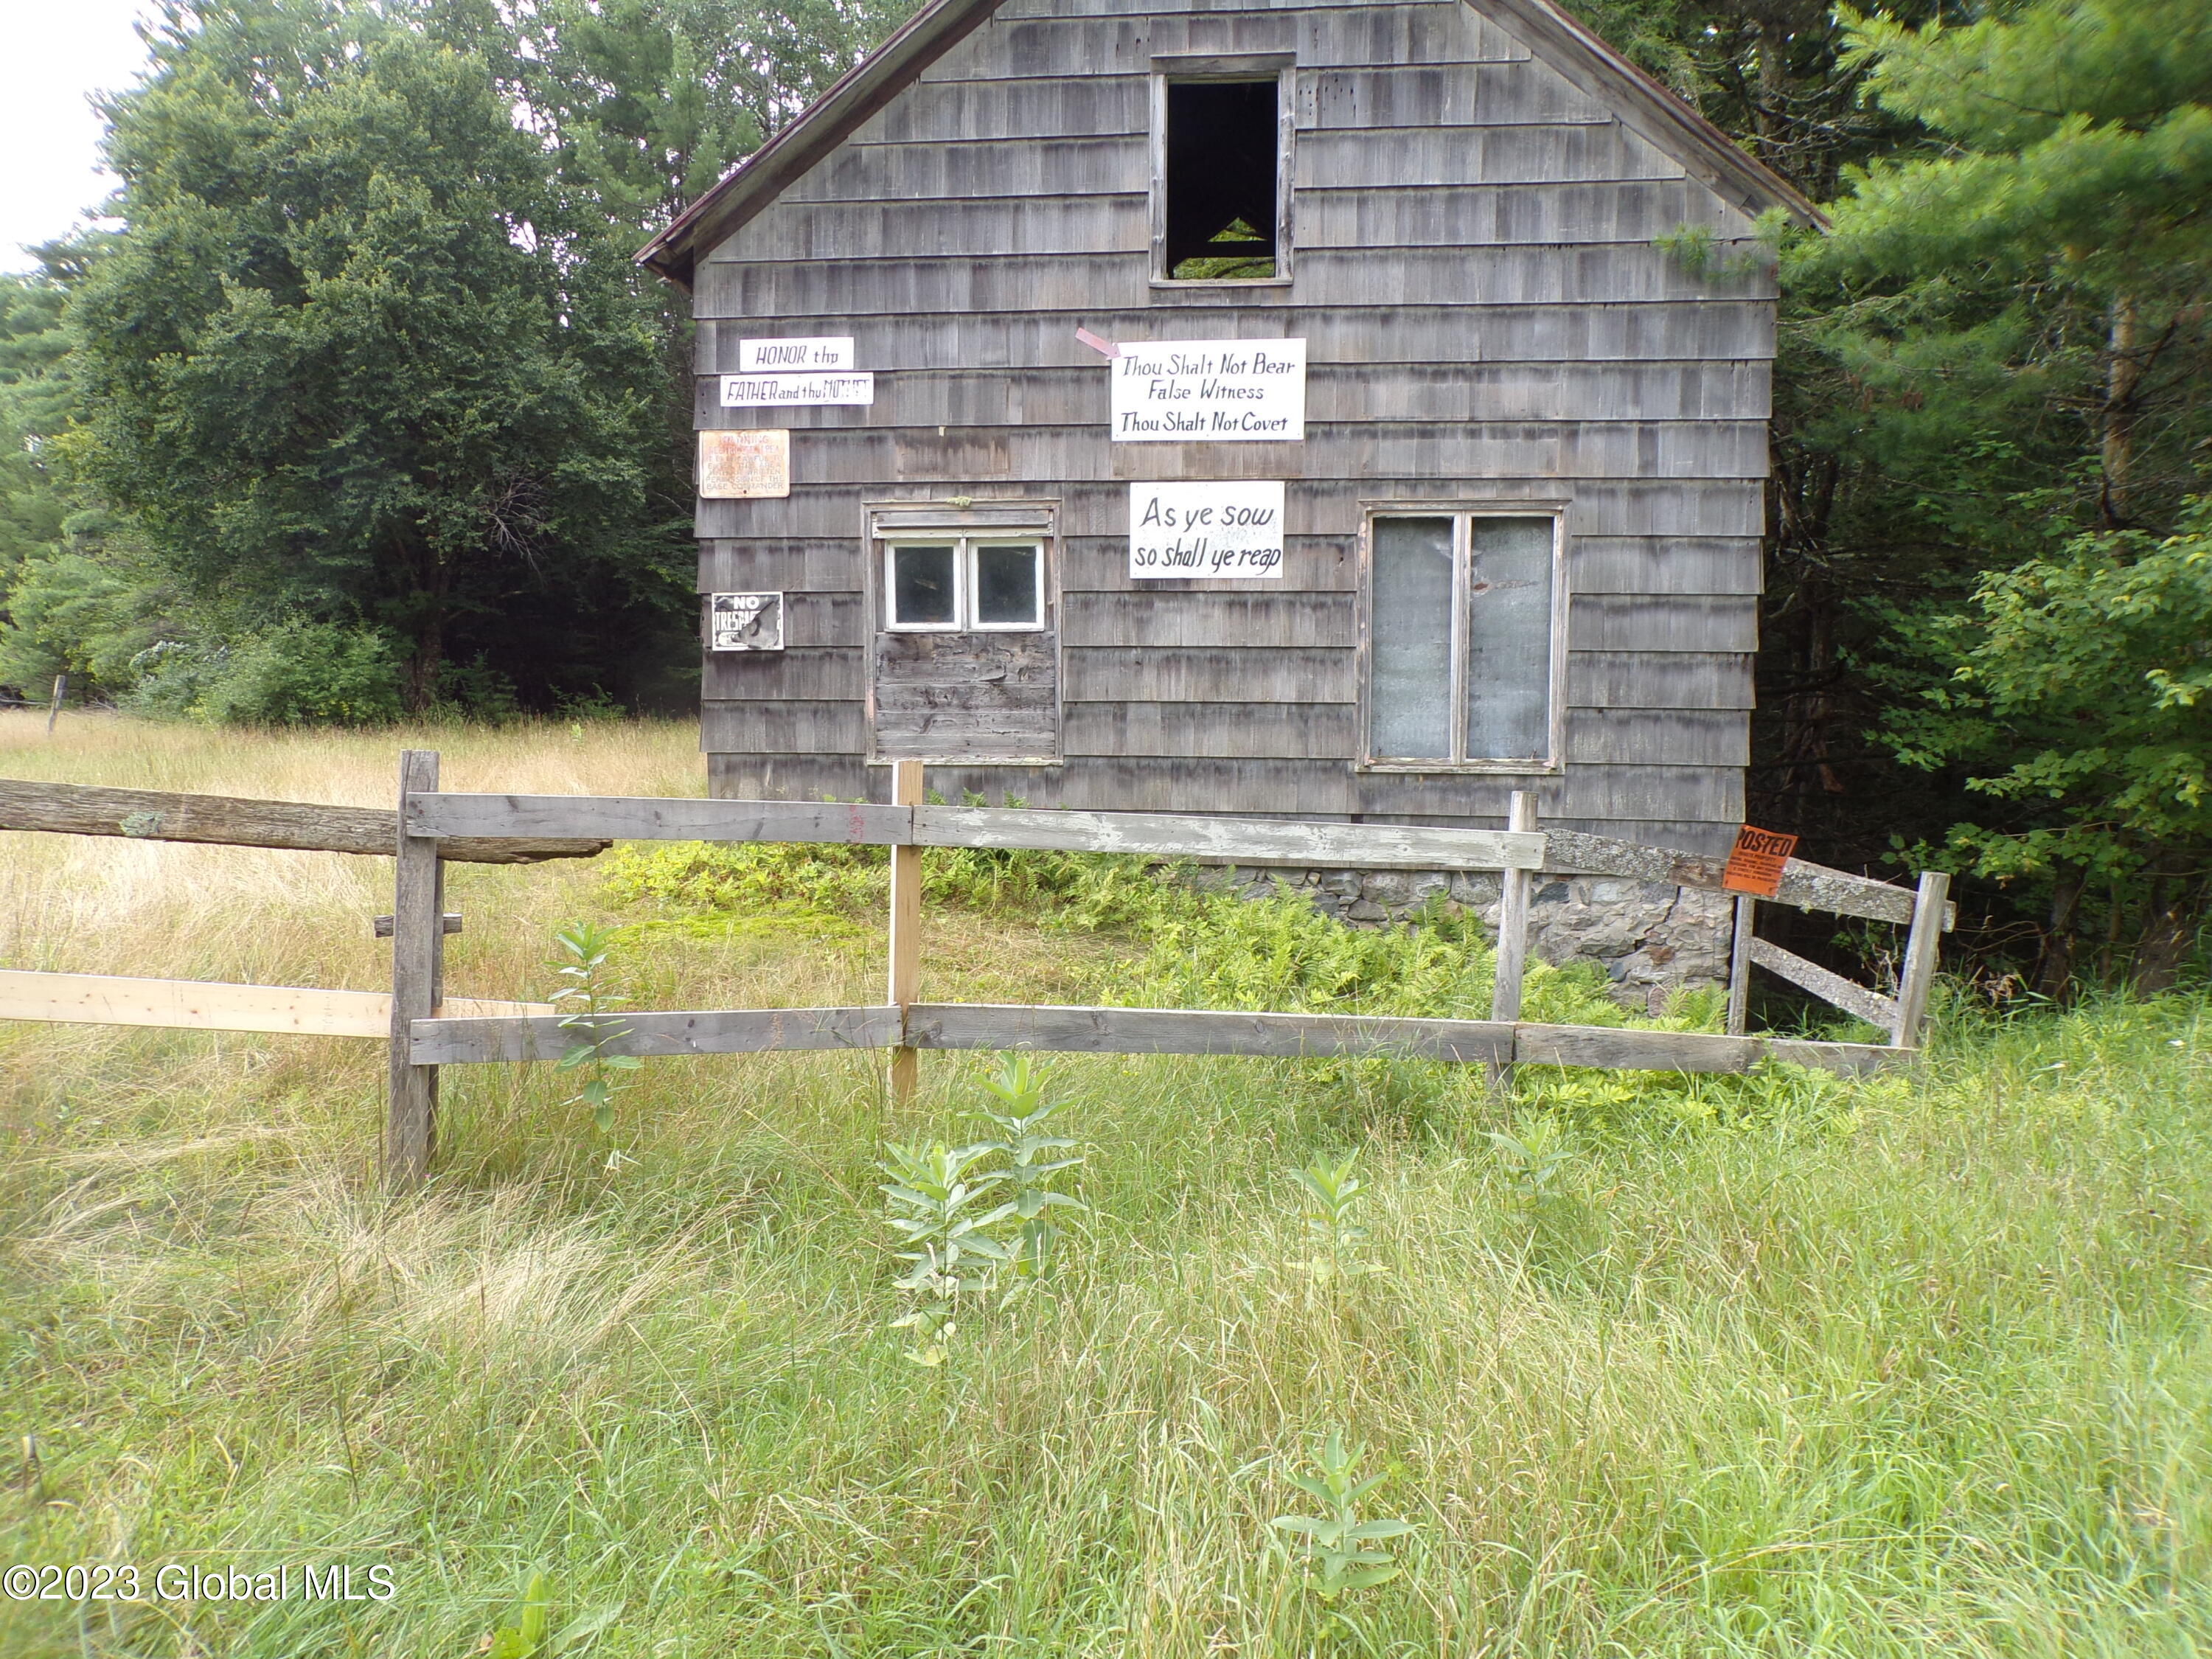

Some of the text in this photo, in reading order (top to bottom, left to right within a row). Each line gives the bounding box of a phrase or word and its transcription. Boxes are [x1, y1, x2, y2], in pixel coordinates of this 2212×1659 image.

[756, 345, 807, 365] HONOR
[1122, 352, 1296, 377] Thou Shalt Not Bear
[727, 378, 870, 402] FATHER and thy MOT
[1147, 378, 1265, 400] False Witness
[1120, 411, 1289, 432] Thou Shalt Not Covet
[1138, 496, 1275, 533] As ye sow
[1135, 537, 1282, 576] so shall ye reap
[733, 596, 759, 610] NO
[1736, 827, 1793, 858] POSTED
